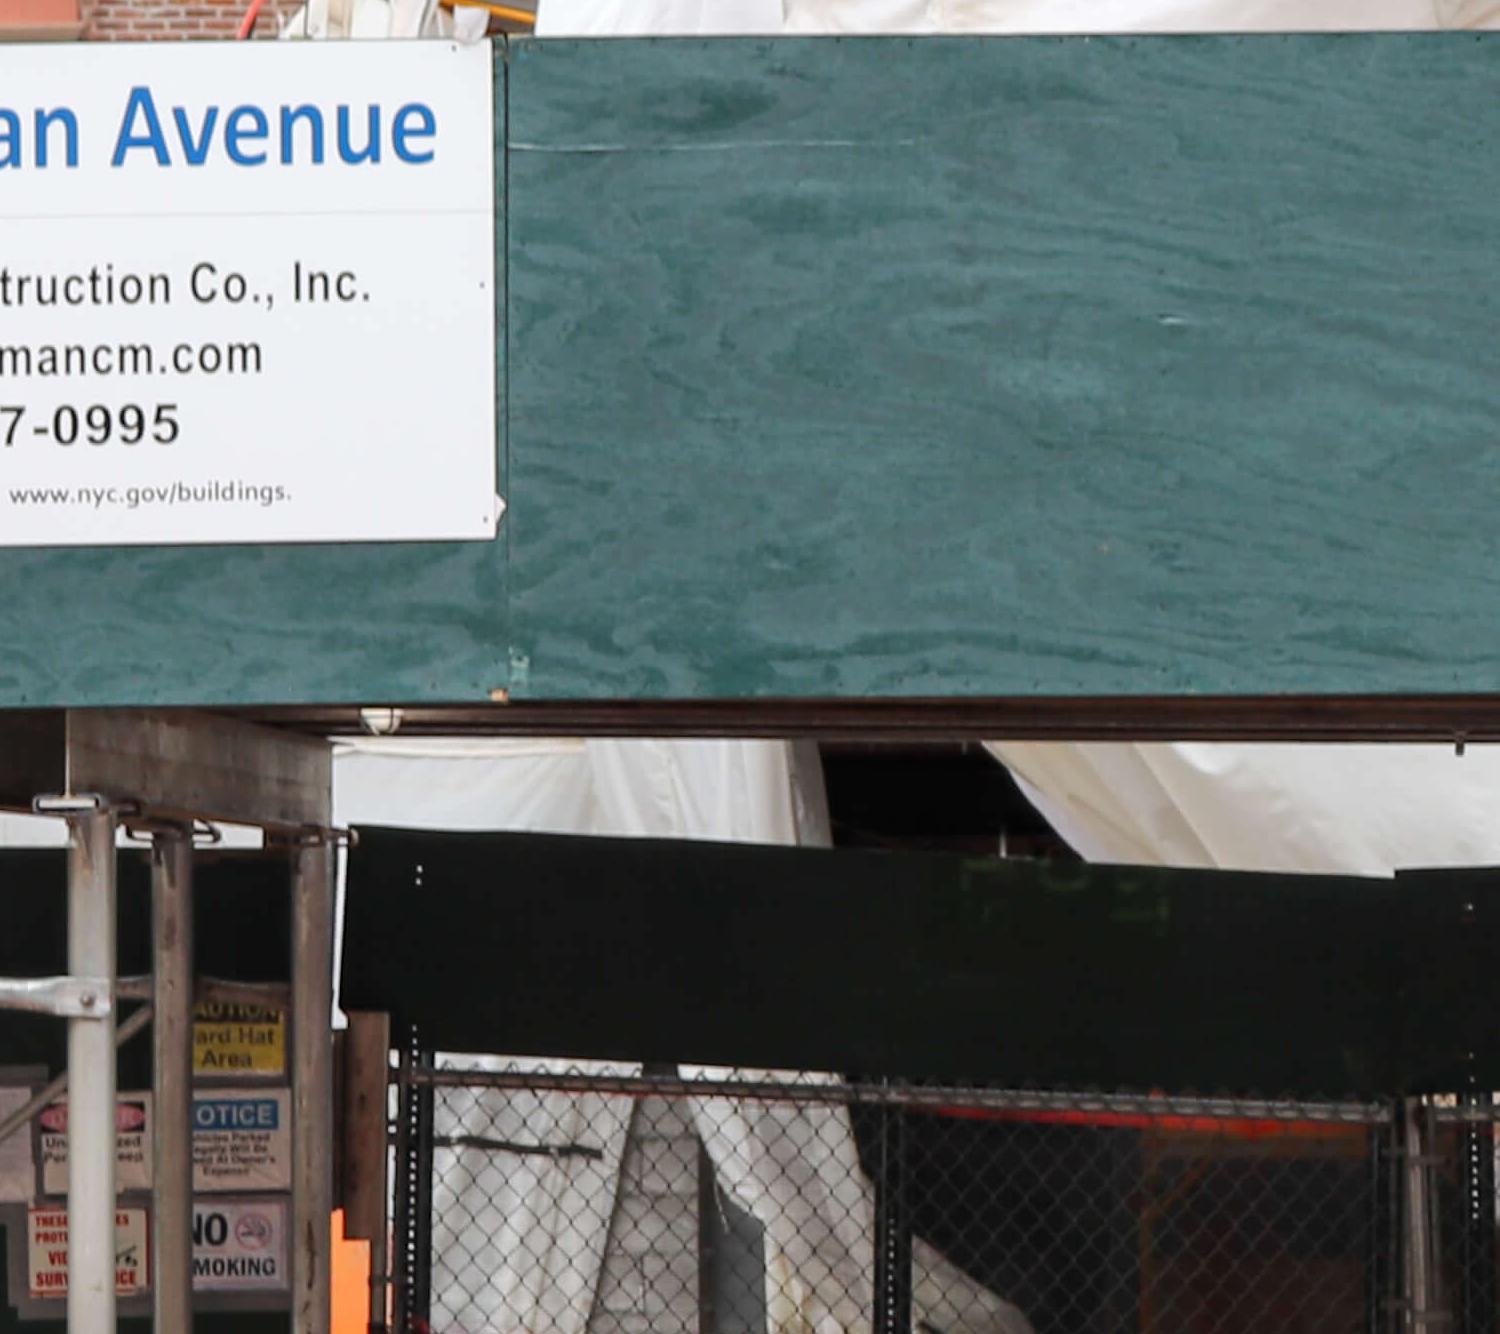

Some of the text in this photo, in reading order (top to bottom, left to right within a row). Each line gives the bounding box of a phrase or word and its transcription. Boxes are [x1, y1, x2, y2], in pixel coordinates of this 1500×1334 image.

[111, 86, 436, 167] Avenue
[191, 262, 273, 309] Co.,
[295, 261, 369, 302] Inc.
[10, 482, 291, 509] www.nyc.gov/buildings.
[195, 1029, 230, 1045] ard
[201, 1050, 252, 1067] Area
[195, 1104, 273, 1126] OTICE
[193, 1258, 275, 1276] MOKING
